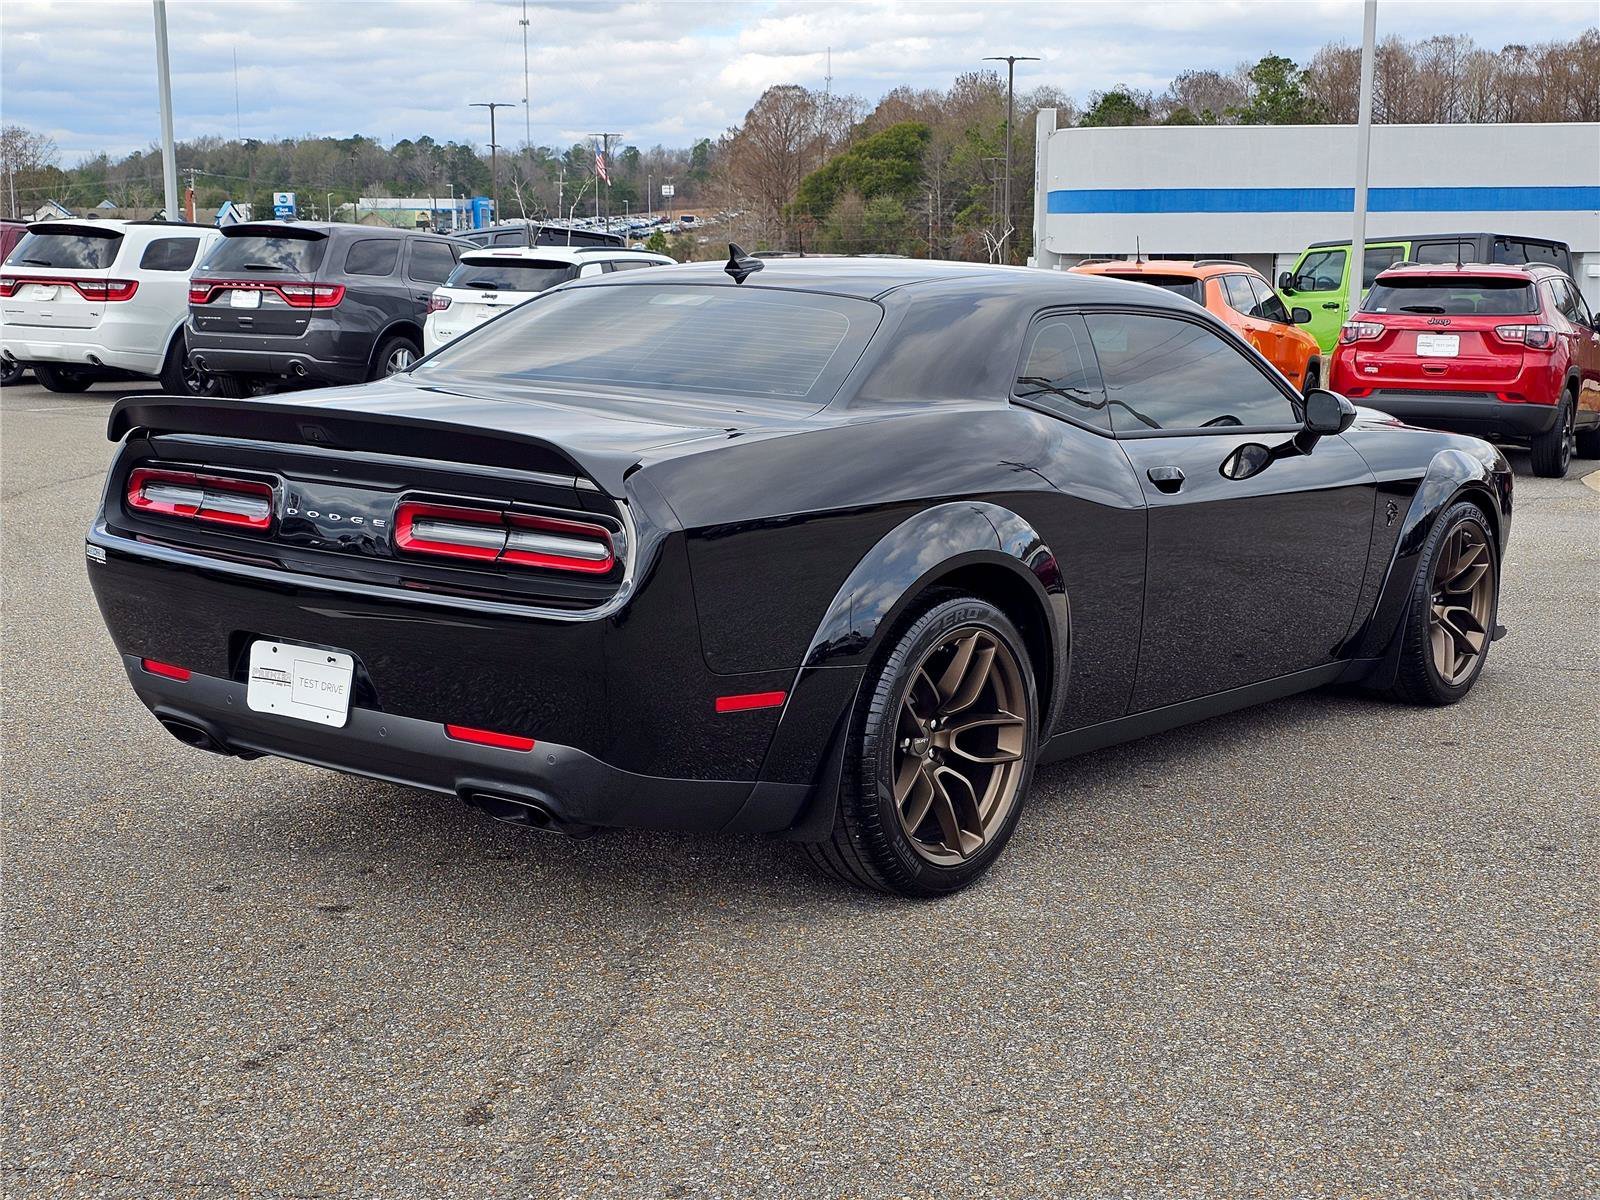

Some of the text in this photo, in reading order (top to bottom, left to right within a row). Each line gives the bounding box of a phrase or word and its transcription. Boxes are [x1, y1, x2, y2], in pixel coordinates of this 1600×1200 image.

[1427, 317, 1451, 326] Jeep
[286, 507, 386, 527] DODGE
[1464, 508, 1487, 526] ZERO
[299, 676, 319, 689] TEST
[320, 681, 344, 695] DRIVE
